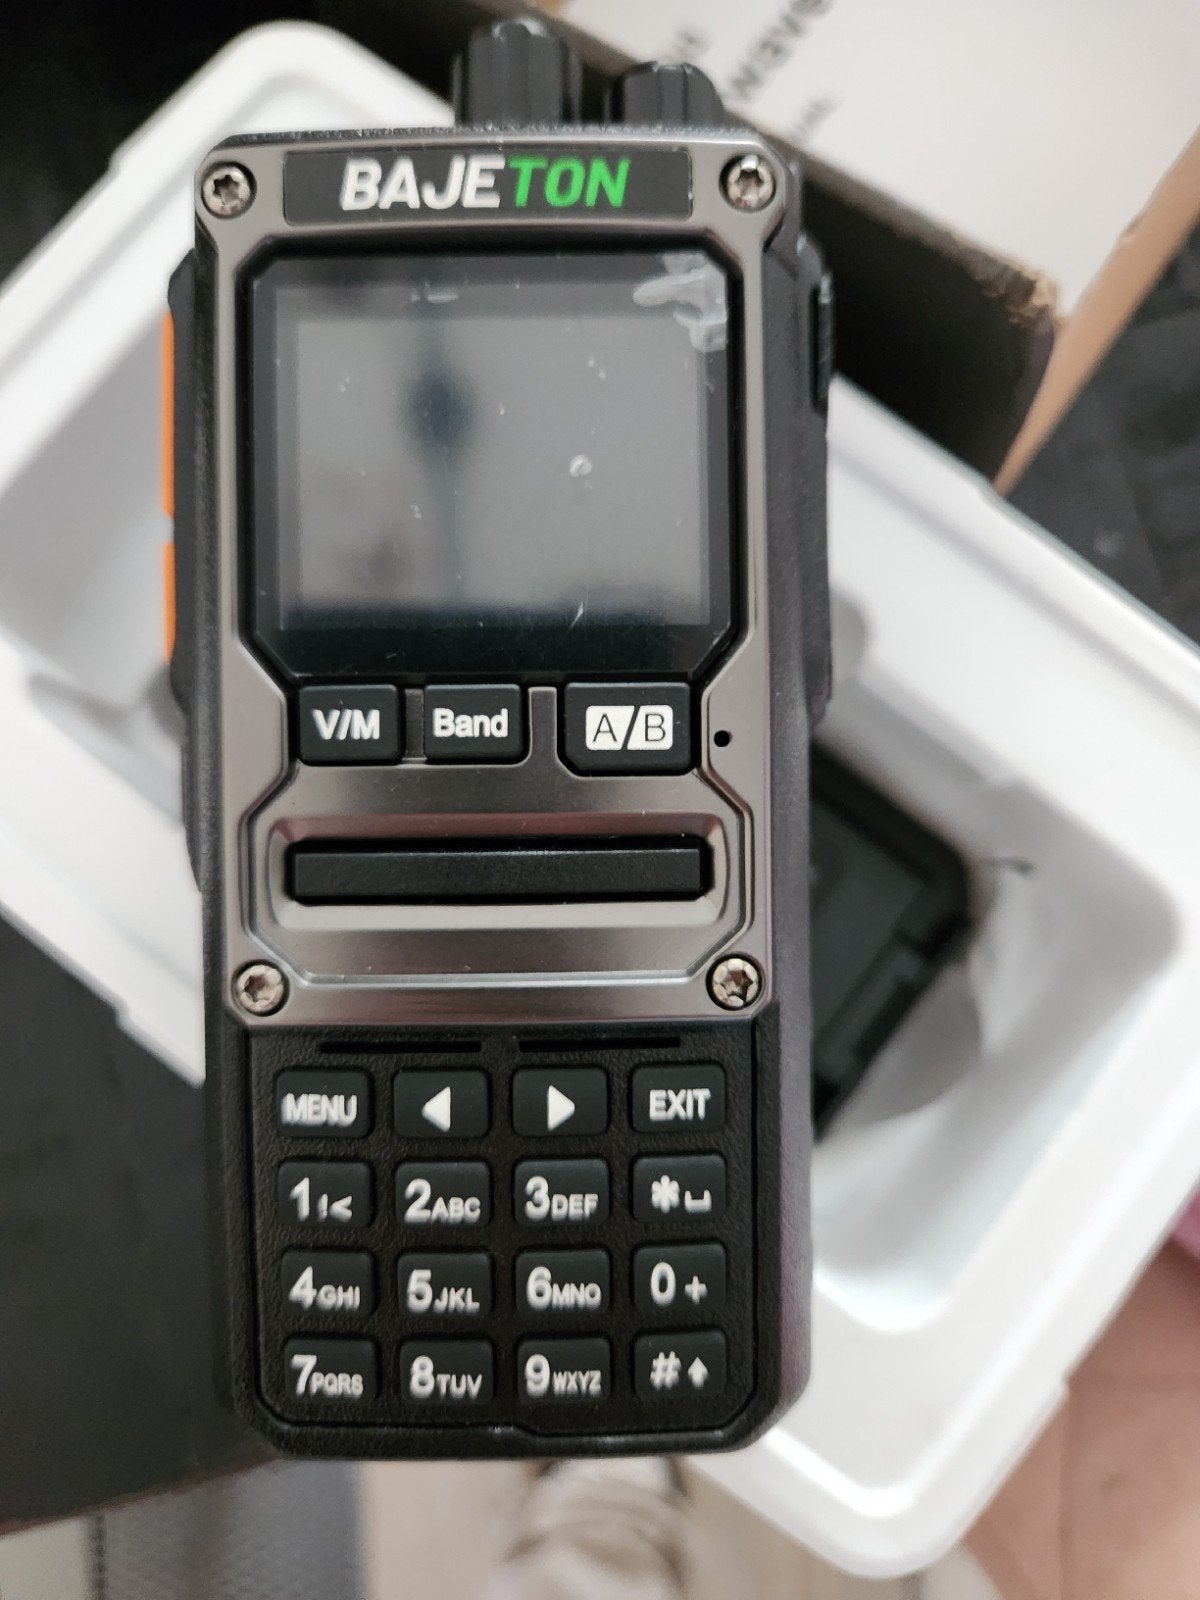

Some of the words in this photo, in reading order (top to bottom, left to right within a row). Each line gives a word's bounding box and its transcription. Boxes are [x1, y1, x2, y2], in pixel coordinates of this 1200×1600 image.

[340, 154, 630, 210] BAJETON
[312, 708, 381, 741] V/M
[432, 707, 509, 738] Band
[589, 708, 670, 748] A/B
[281, 1092, 358, 1127] MENU
[649, 1087, 712, 1121] EXIT
